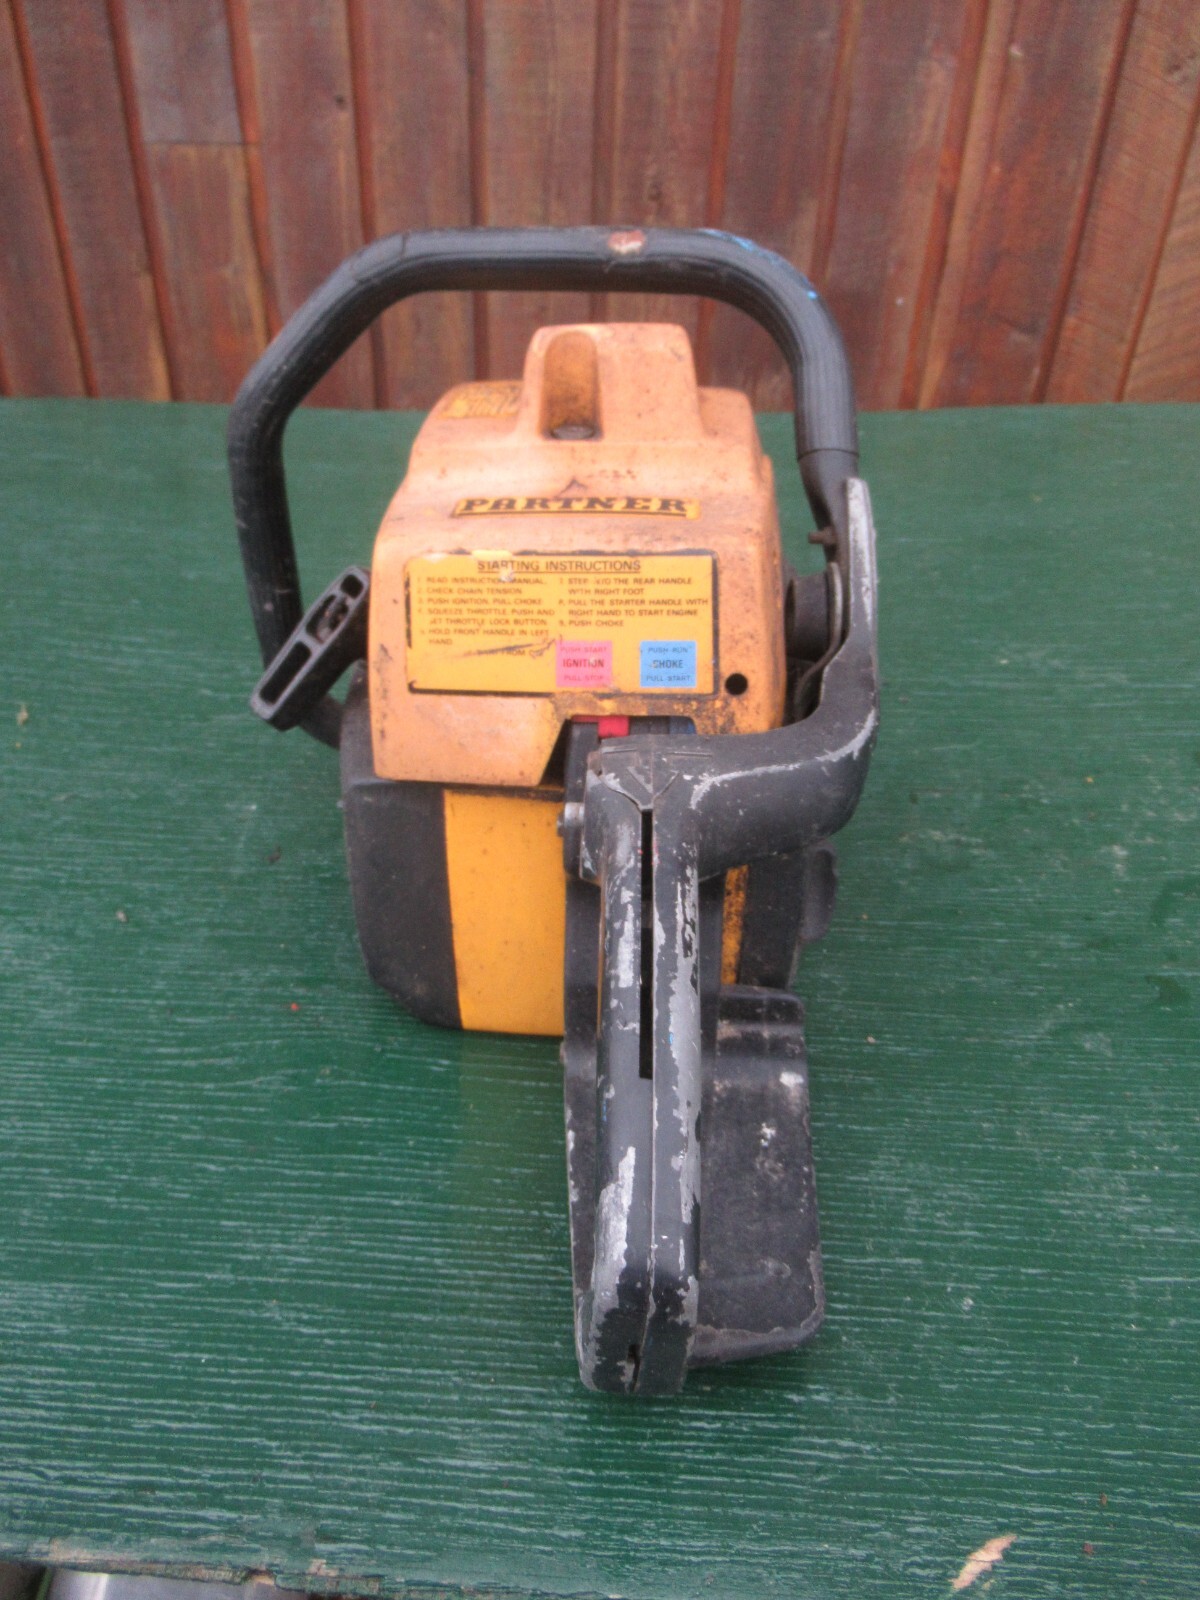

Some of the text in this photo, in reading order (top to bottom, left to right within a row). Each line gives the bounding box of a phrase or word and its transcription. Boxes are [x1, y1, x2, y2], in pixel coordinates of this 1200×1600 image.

[461, 496, 688, 513] PARTNER
[477, 560, 641, 571] STARTING INSTRUCTIONS
[563, 659, 604, 668] IGNITION
